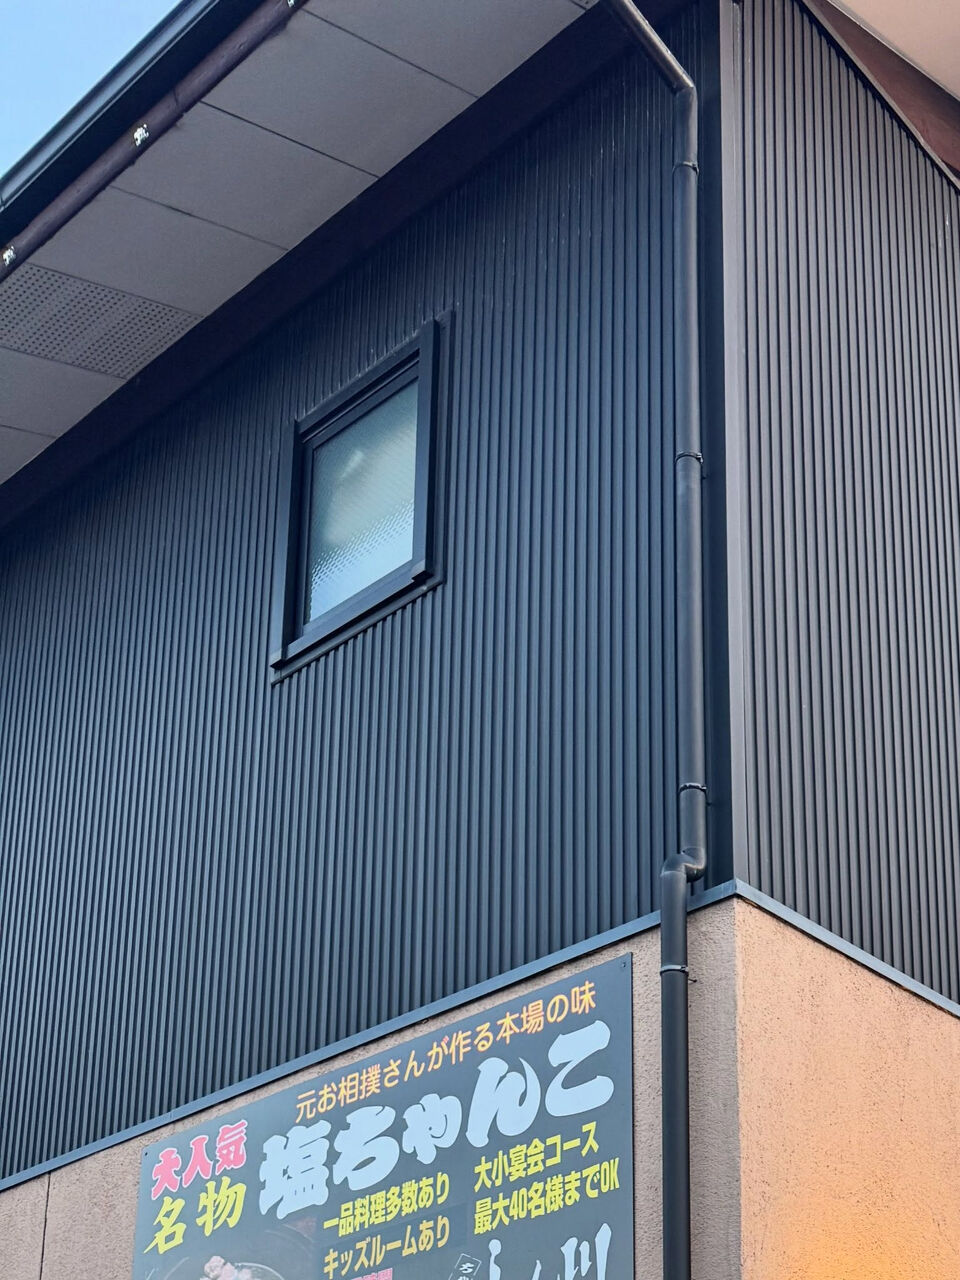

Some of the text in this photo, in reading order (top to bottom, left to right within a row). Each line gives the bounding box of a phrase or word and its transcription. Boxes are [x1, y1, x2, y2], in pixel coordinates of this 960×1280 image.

[295, 981, 597, 1123] 元お相撲さんが作る本場の味
[259, 1020, 614, 1220] 塩ちゃんこ
[474, 1122, 599, 1193] 大小宴会コース
[152, 1120, 248, 1199] 大人気
[474, 1158, 620, 1235] 最大40名様までOK
[144, 1176, 247, 1256] 名物
[323, 1172, 449, 1237] 一品料理多数あり
[323, 1215, 450, 1280] キッズルームあり
